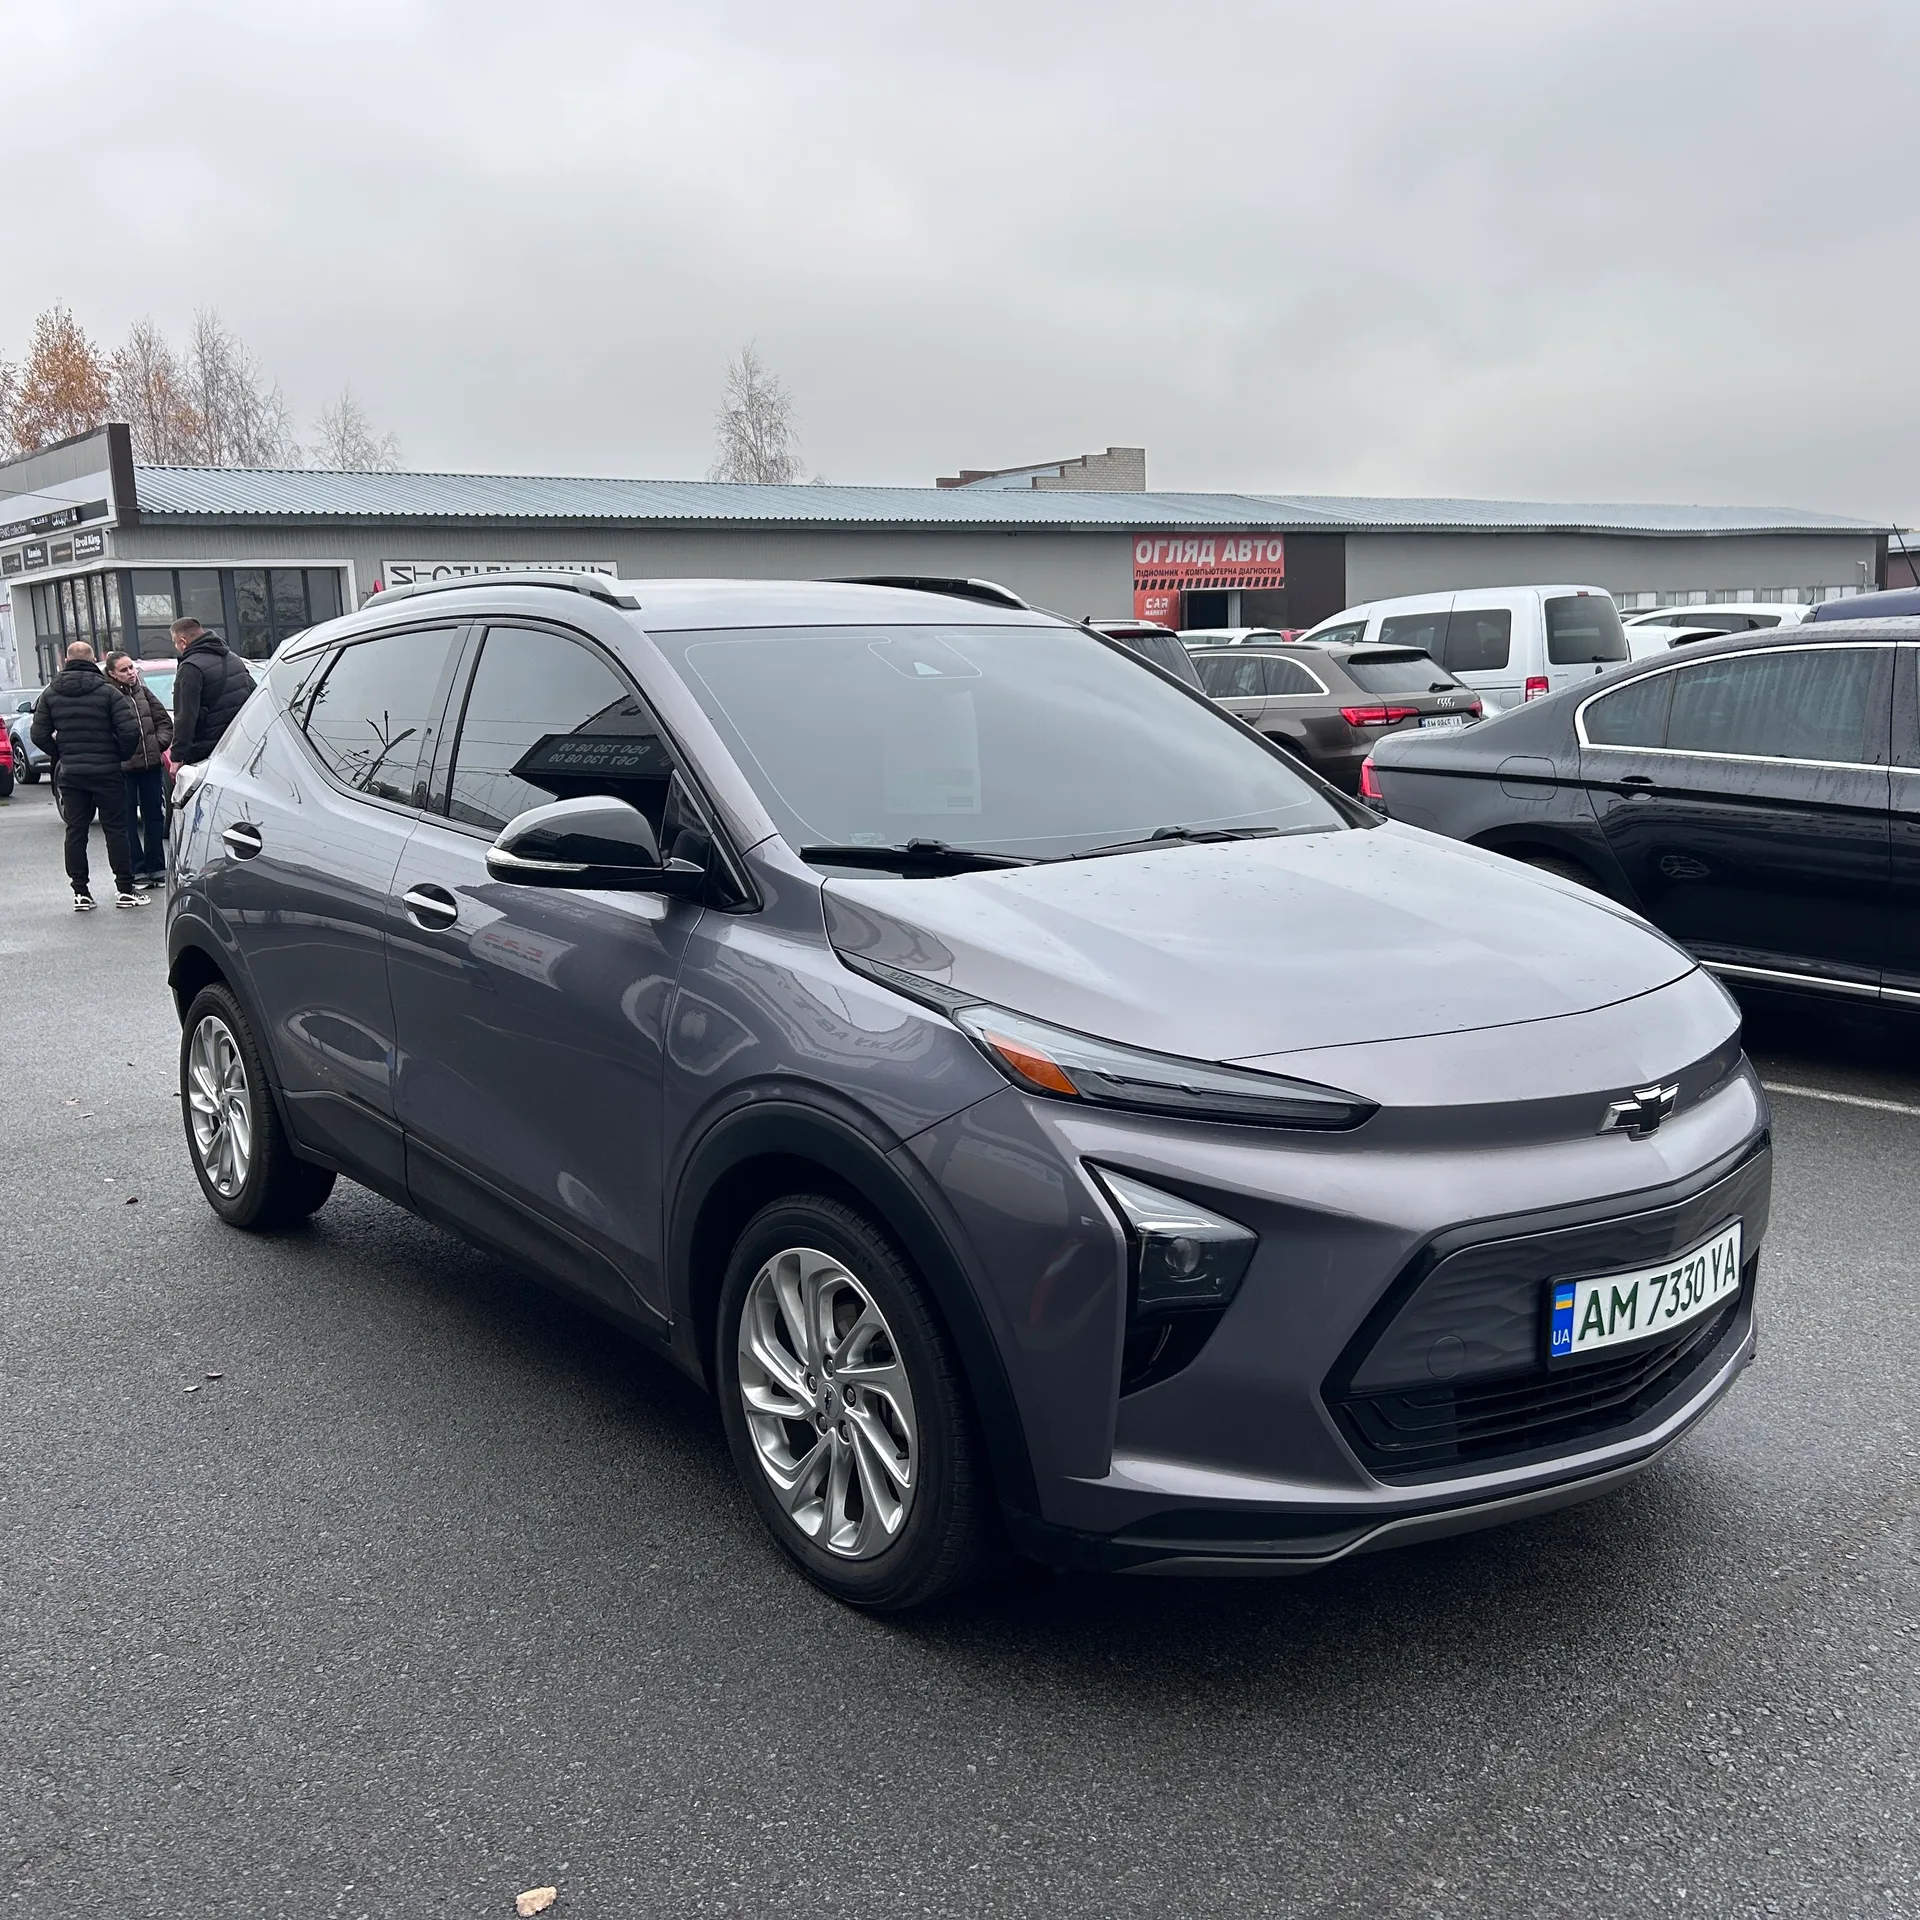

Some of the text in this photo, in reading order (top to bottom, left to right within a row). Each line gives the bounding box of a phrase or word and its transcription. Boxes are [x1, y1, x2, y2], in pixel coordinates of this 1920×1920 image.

[1135, 539, 1282, 567] ОГЛЯД АВТО
[1136, 568, 1179, 578] ПІДЙОМНИК
[1145, 597, 1168, 609] CAR
[1578, 1237, 1737, 1341] AM 7330 YA
[1552, 1328, 1571, 1346] UA
